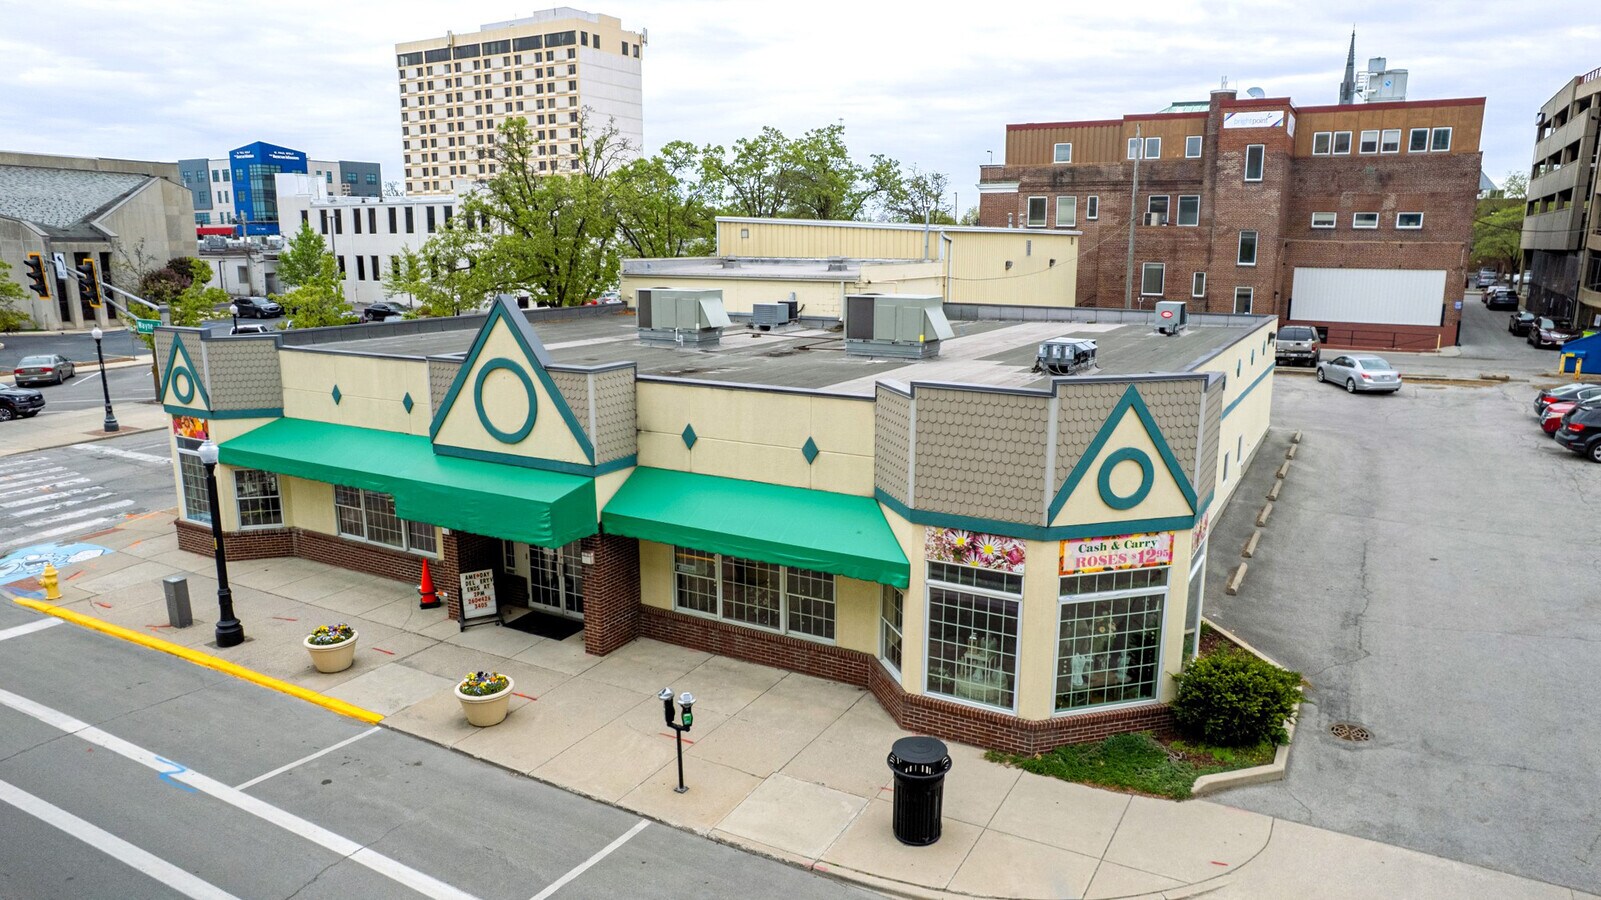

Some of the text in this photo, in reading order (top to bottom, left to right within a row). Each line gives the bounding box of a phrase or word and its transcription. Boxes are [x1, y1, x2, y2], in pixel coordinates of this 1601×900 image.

[1078, 539, 1158, 553] Cash & Carry
[1075, 553, 1128, 568] ROSES
